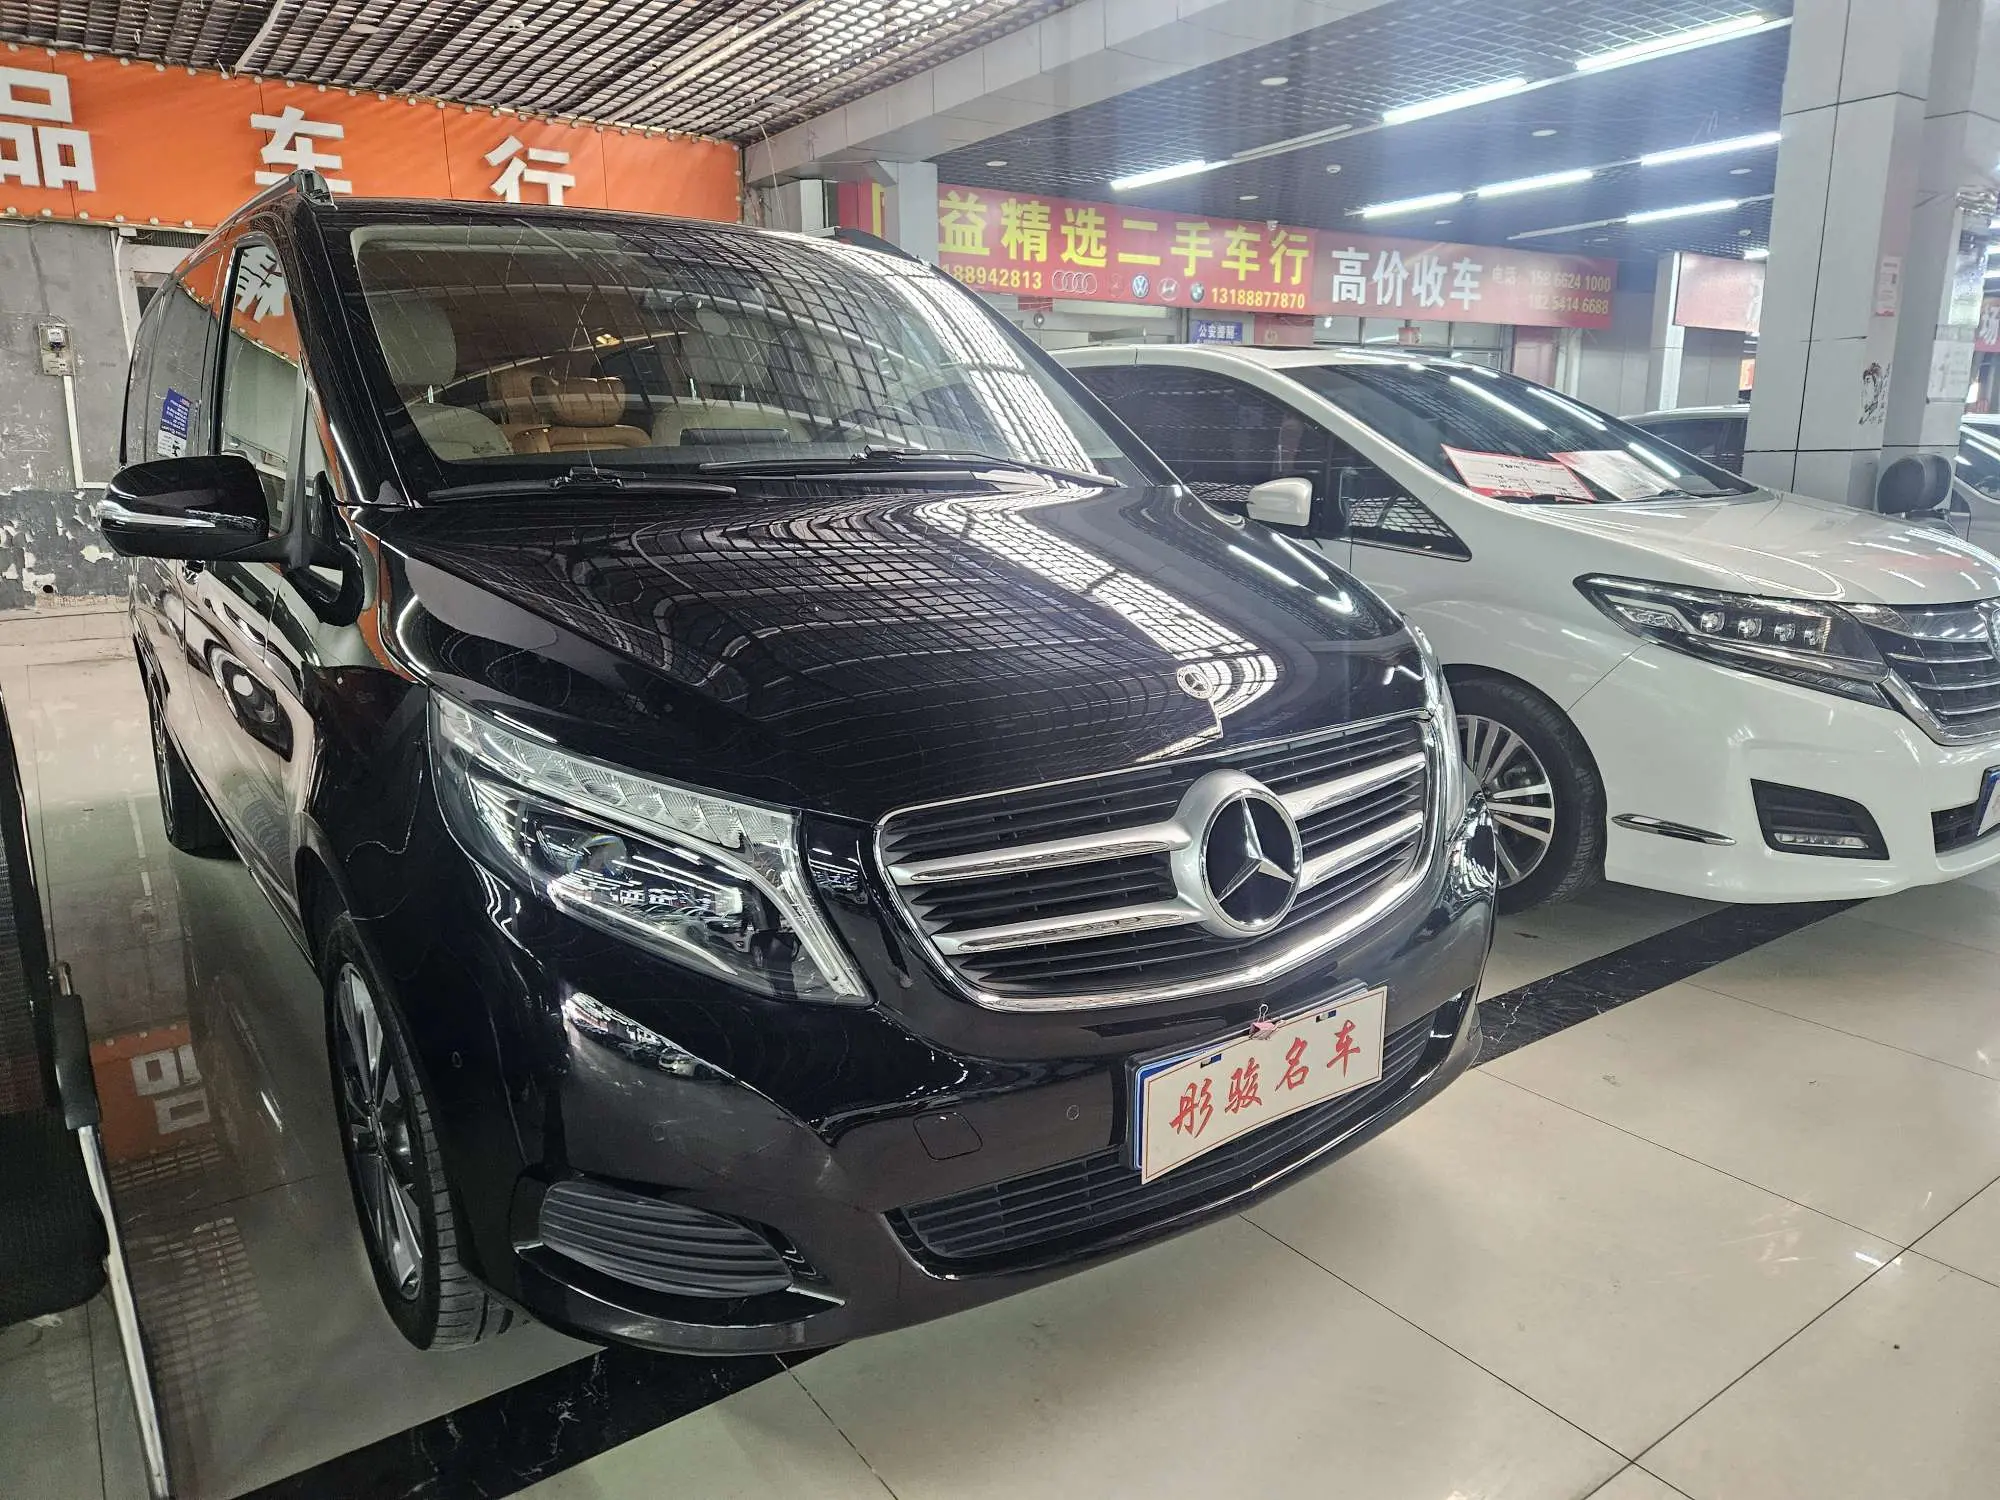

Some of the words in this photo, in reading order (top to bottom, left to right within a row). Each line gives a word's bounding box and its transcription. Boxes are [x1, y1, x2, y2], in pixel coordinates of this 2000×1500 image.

[938, 190, 1309, 286] 益精选二手车行
[1331, 246, 1482, 312] 高价收车
[1554, 271, 1582, 290] 6624
[1585, 275, 1612, 293] 1000
[1211, 287, 1306, 310] 13188877870
[1582, 297, 1609, 315] 6688
